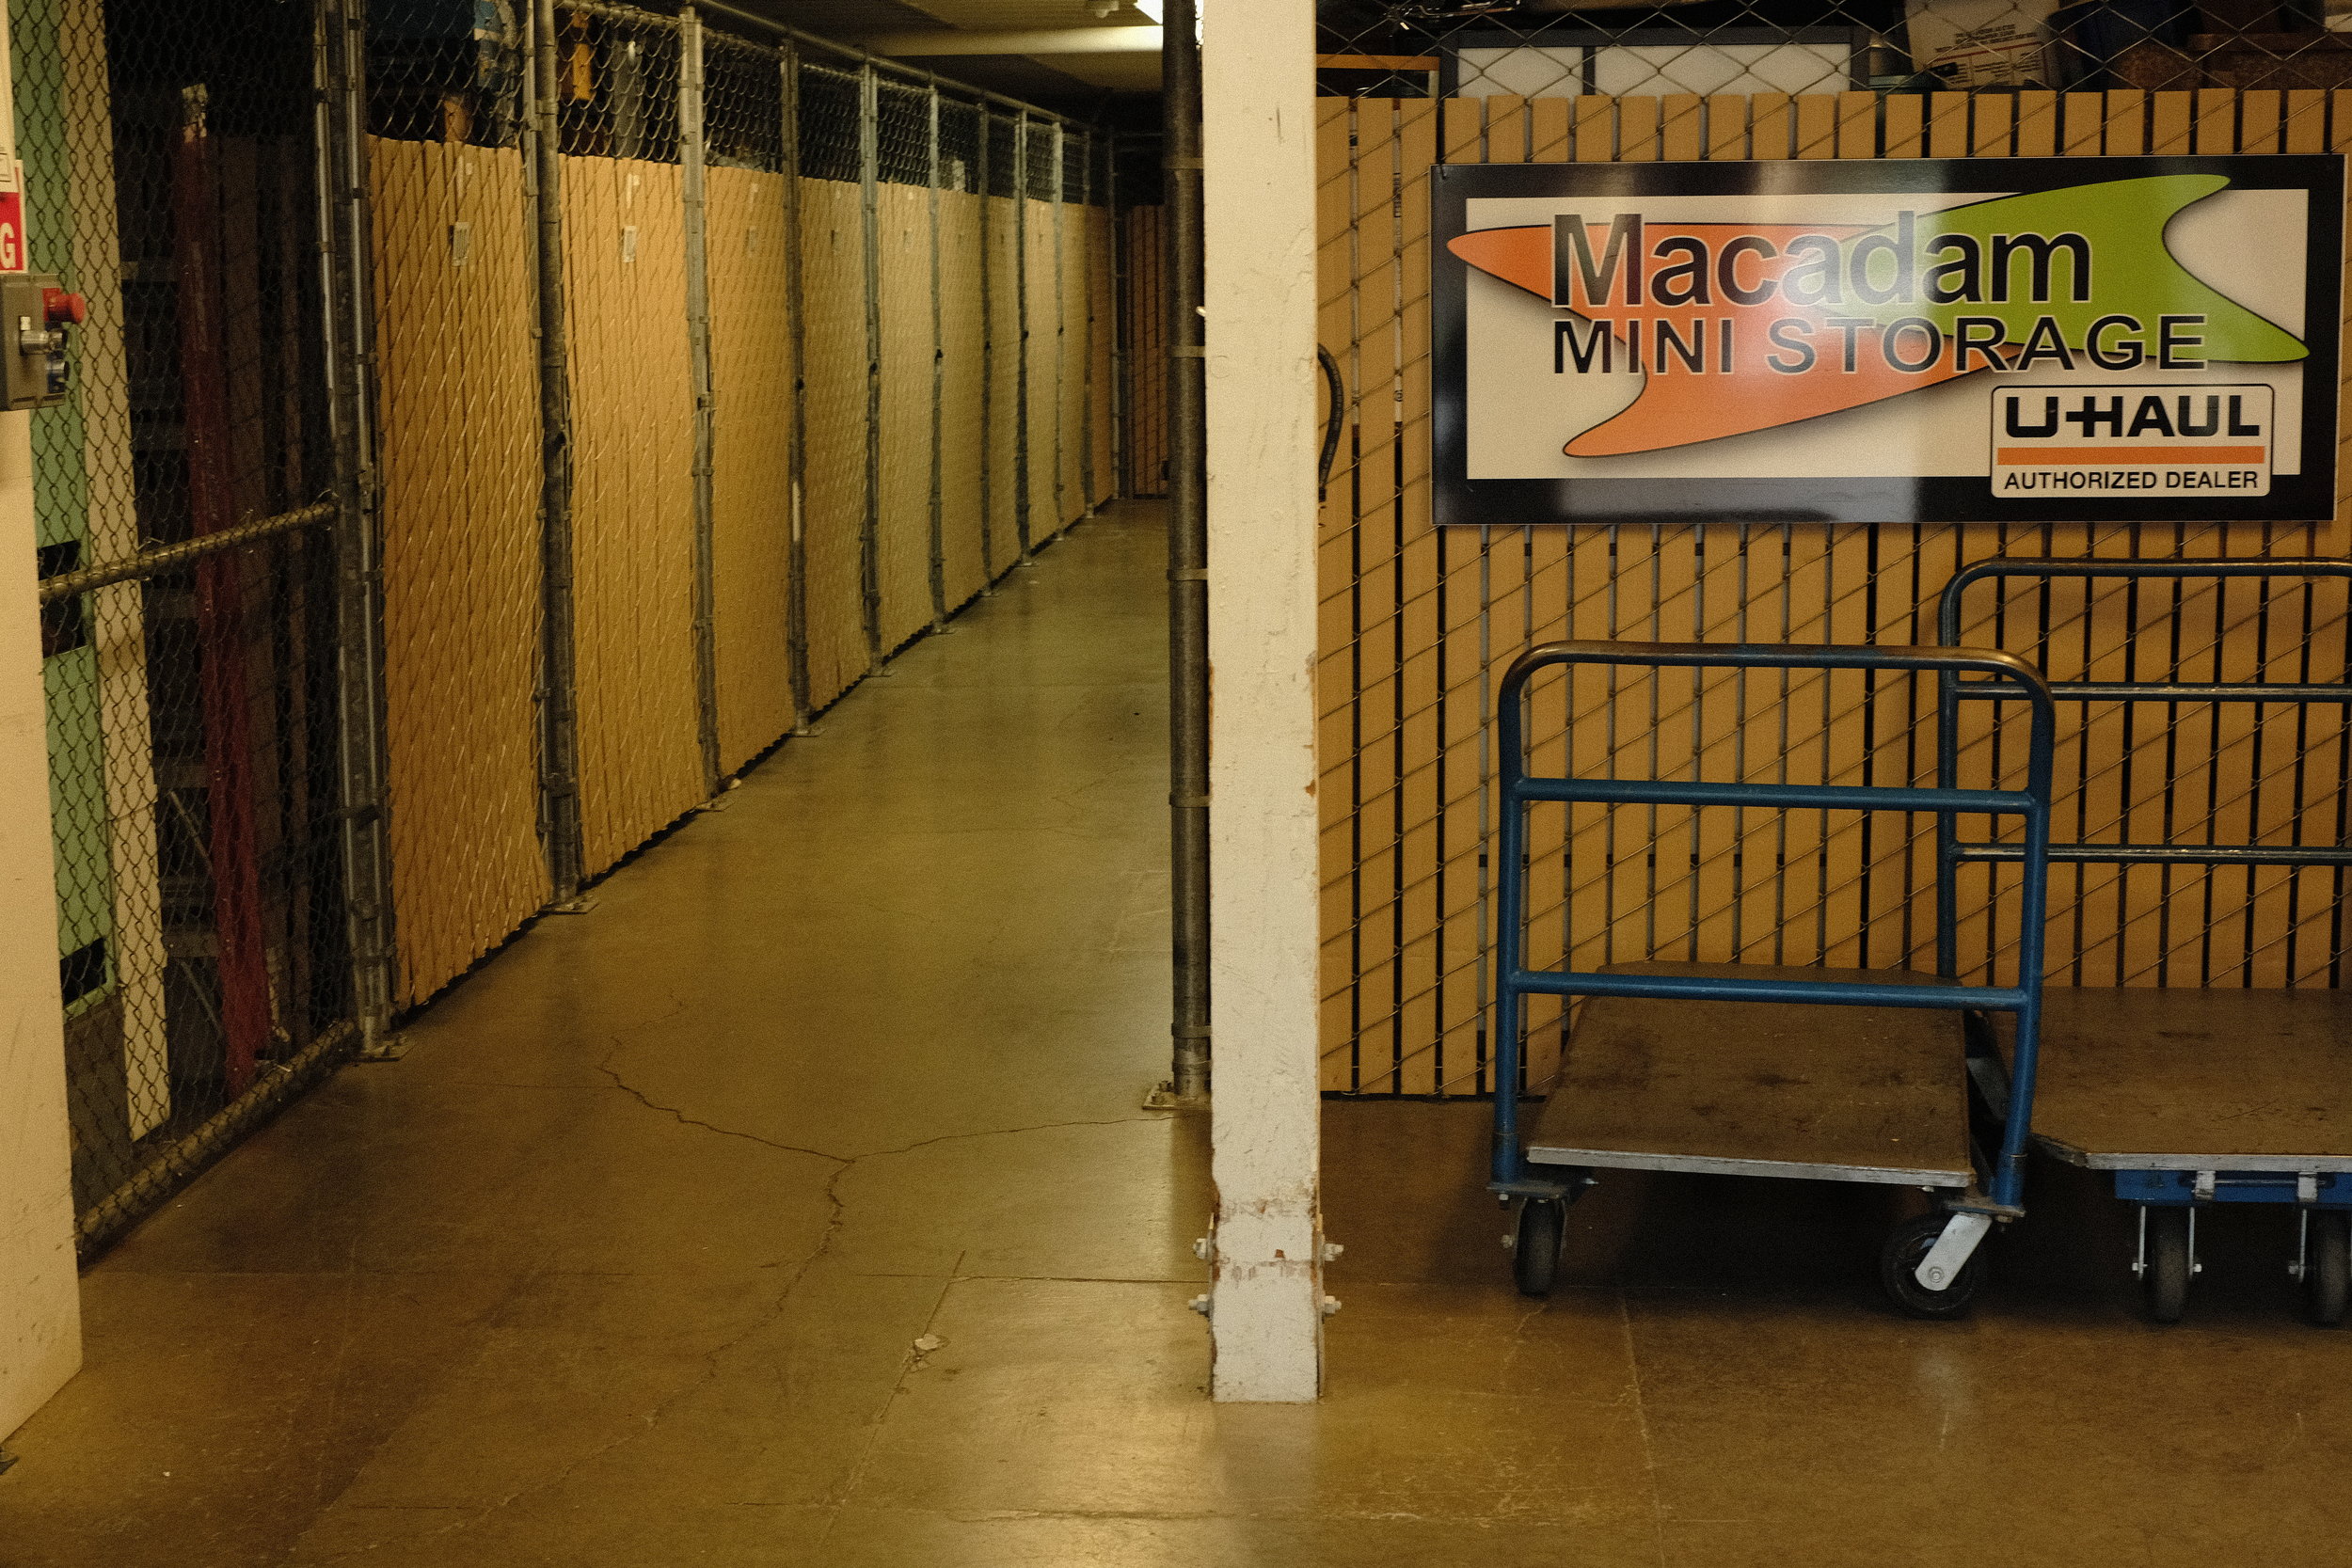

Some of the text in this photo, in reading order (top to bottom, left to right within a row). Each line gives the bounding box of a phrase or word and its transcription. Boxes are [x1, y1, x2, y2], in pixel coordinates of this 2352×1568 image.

[1553, 209, 2091, 308] Macadam
[1553, 314, 2206, 374] MINI STORAGE
[2006, 394, 2260, 438] U-HAUL
[2004, 470, 2258, 490] AUTHORIZED DEALER
